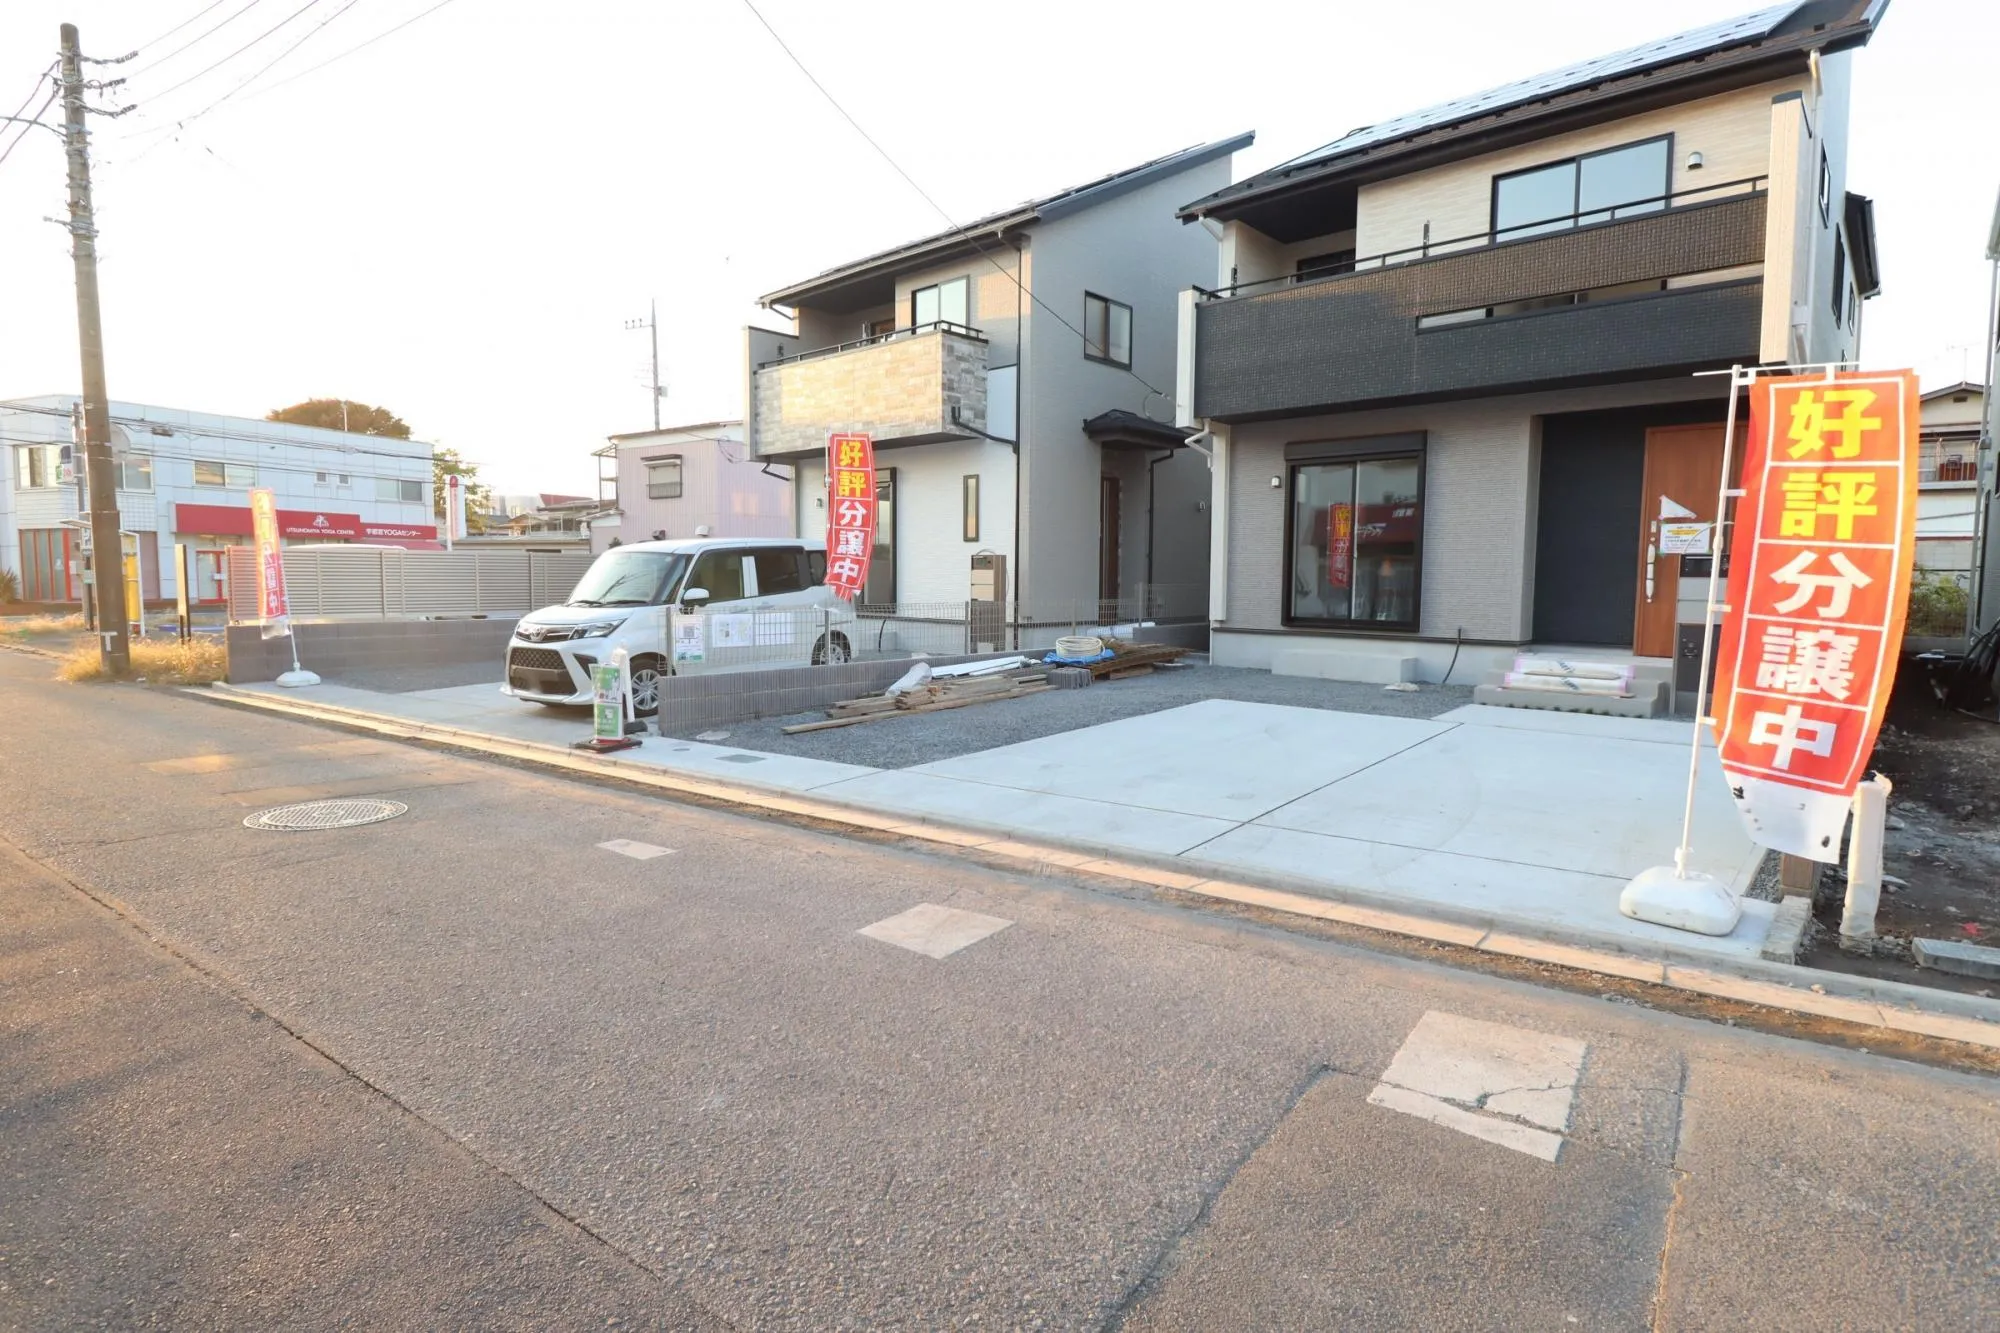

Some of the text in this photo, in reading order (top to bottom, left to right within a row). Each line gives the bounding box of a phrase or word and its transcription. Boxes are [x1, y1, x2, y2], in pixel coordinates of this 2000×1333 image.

[834, 440, 867, 583] 好評分譲中
[1748, 388, 1882, 771] 好評分譲中
